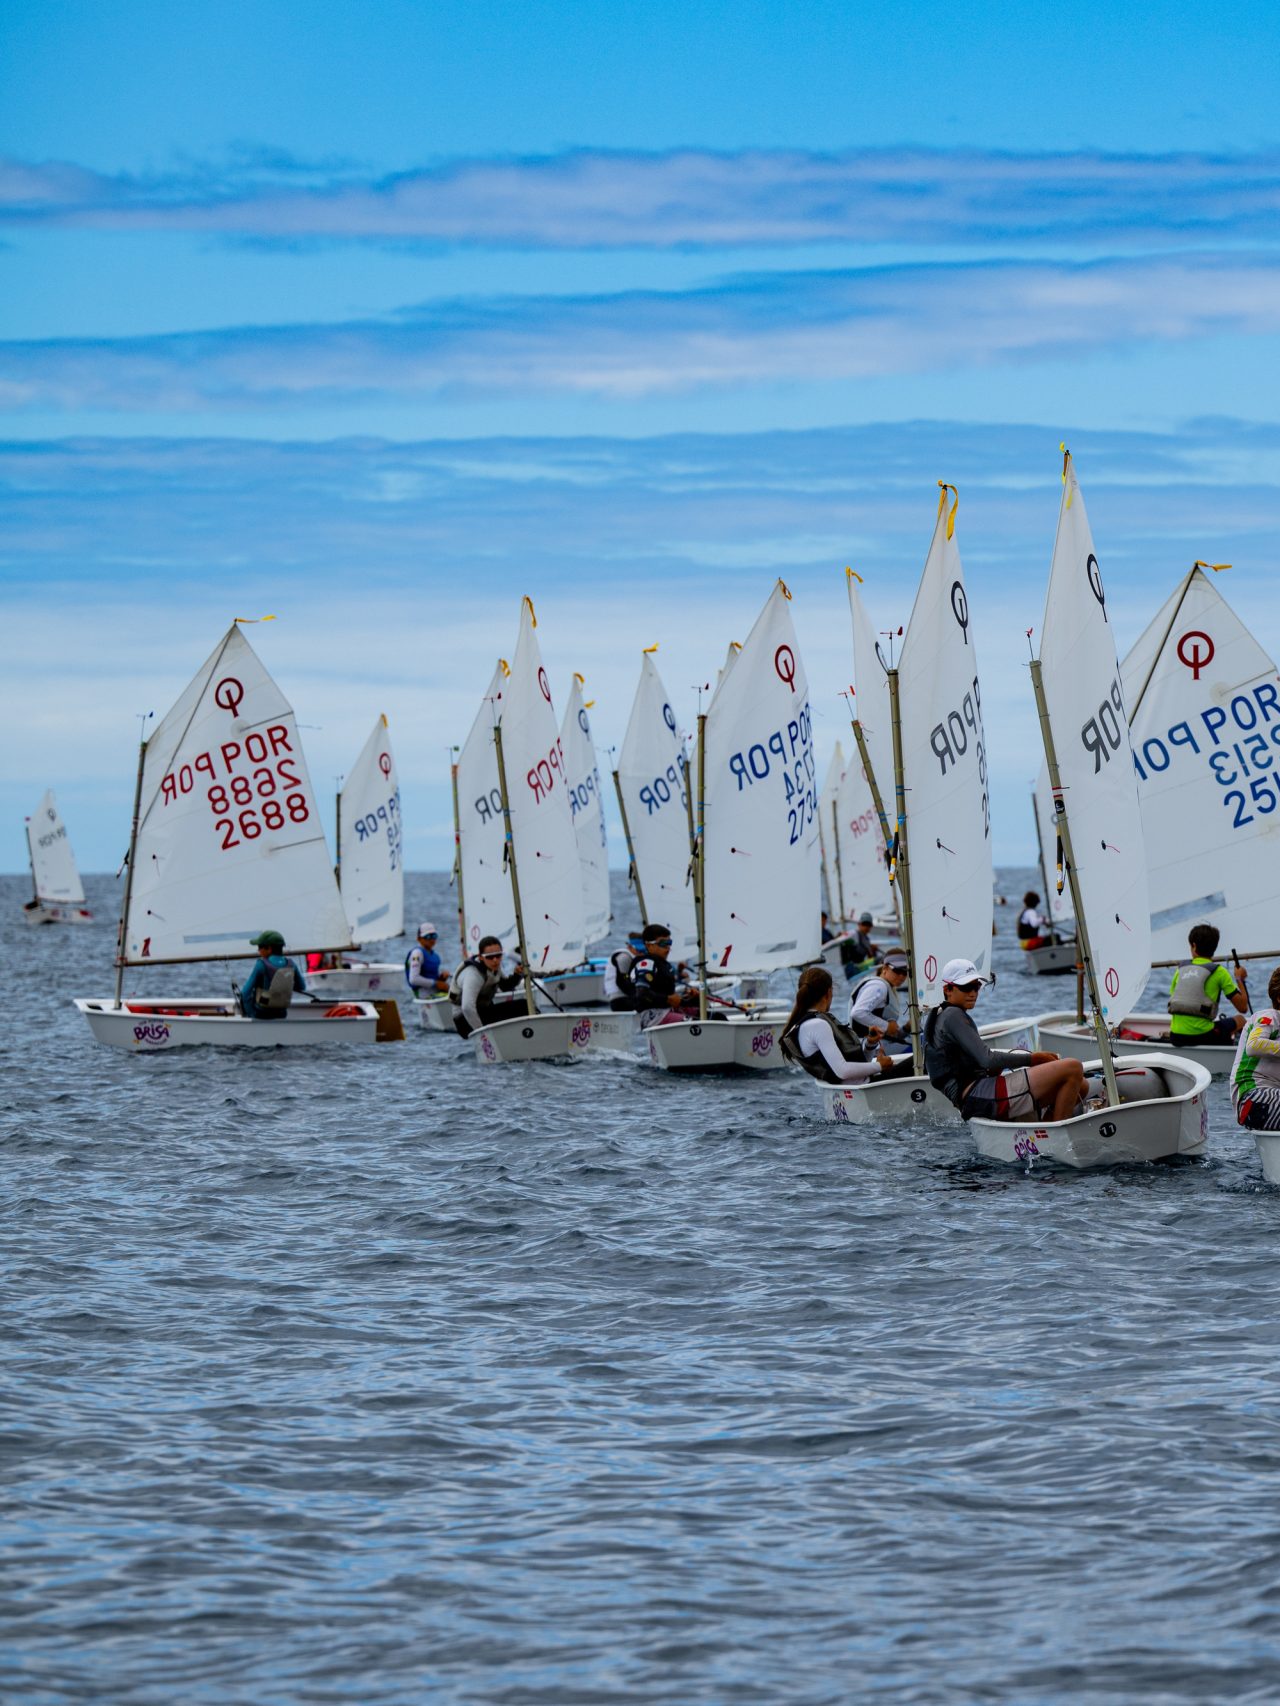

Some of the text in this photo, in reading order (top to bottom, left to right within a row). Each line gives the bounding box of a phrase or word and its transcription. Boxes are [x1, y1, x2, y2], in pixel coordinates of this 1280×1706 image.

[221, 725, 293, 774] POR
[215, 793, 309, 850] 2688
[134, 1024, 169, 1040] BRISA
[915, 1092, 922, 1100] 3
[1102, 1124, 1115, 1135] 11
